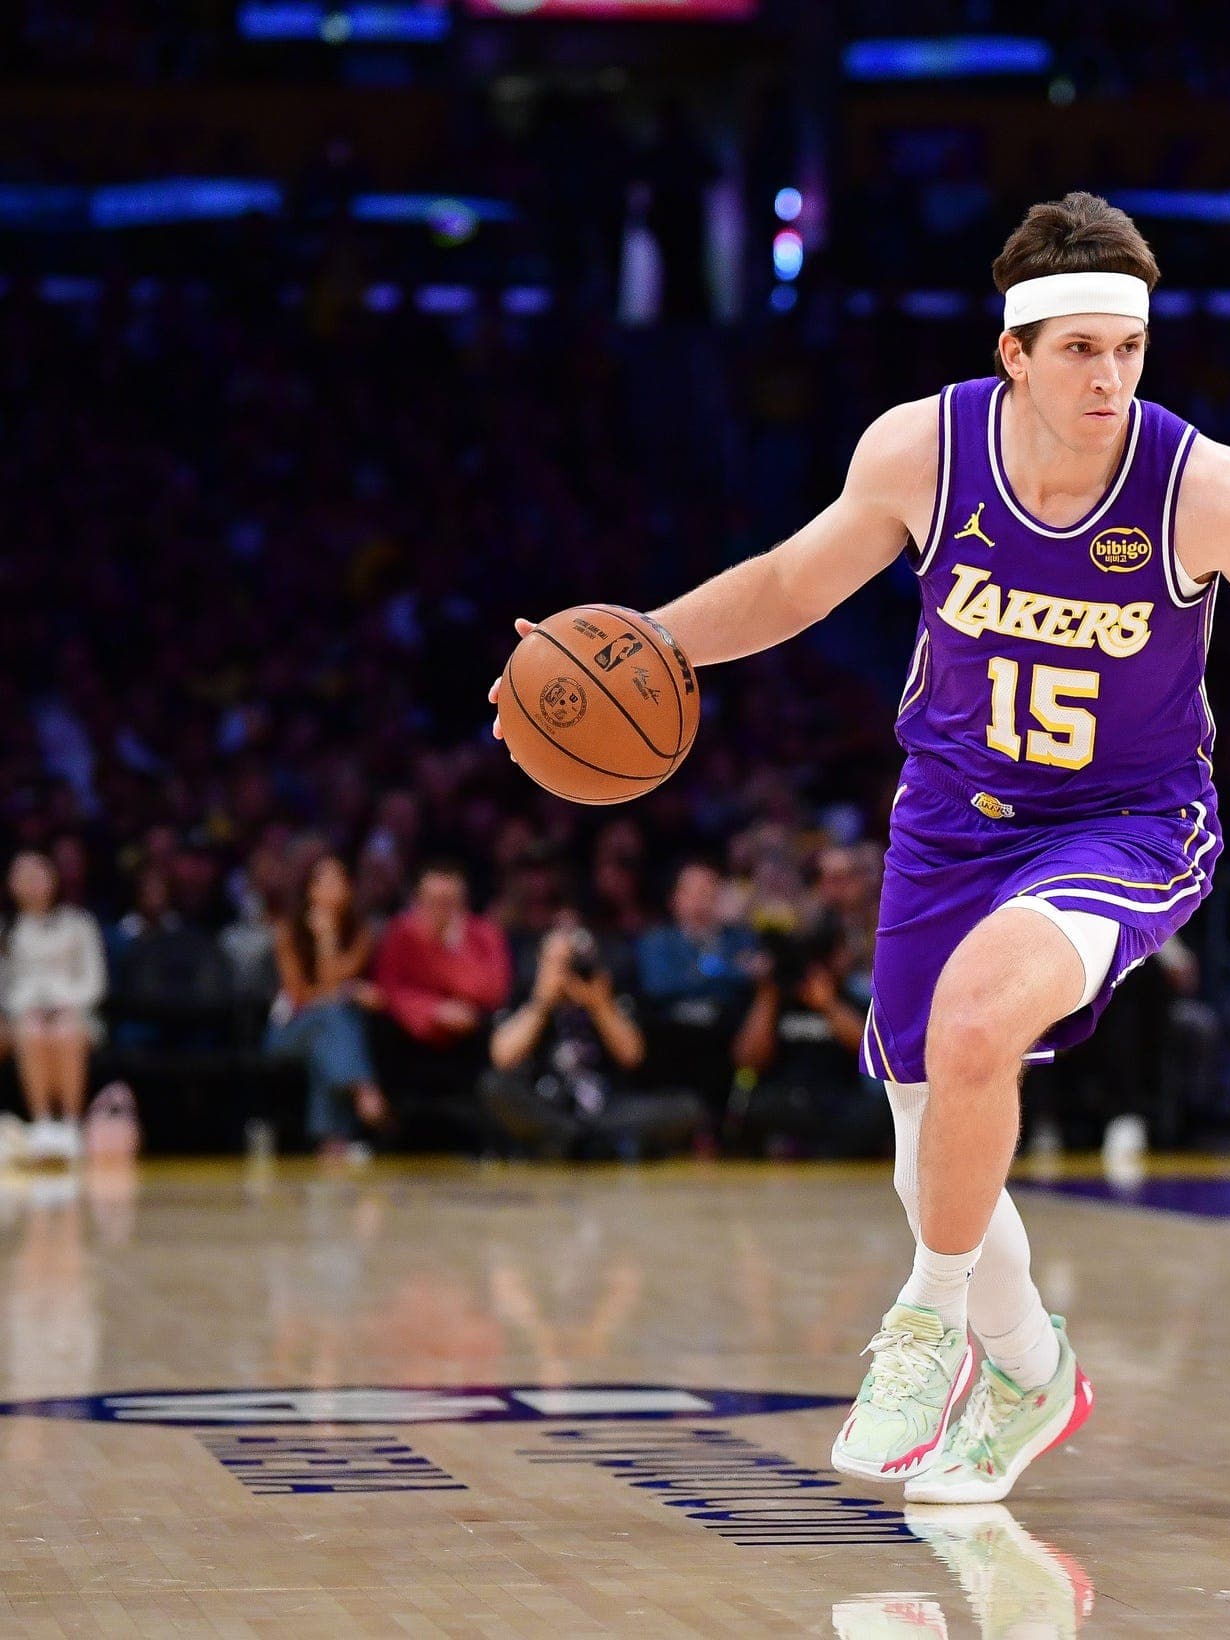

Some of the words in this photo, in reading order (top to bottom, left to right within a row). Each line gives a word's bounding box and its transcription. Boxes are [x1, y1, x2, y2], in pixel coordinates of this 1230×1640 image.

[1096, 539, 1148, 559] bibigo
[1105, 555, 1127, 563] 비비고
[936, 563, 1154, 658] LAKERS
[986, 656, 1100, 770] 15
